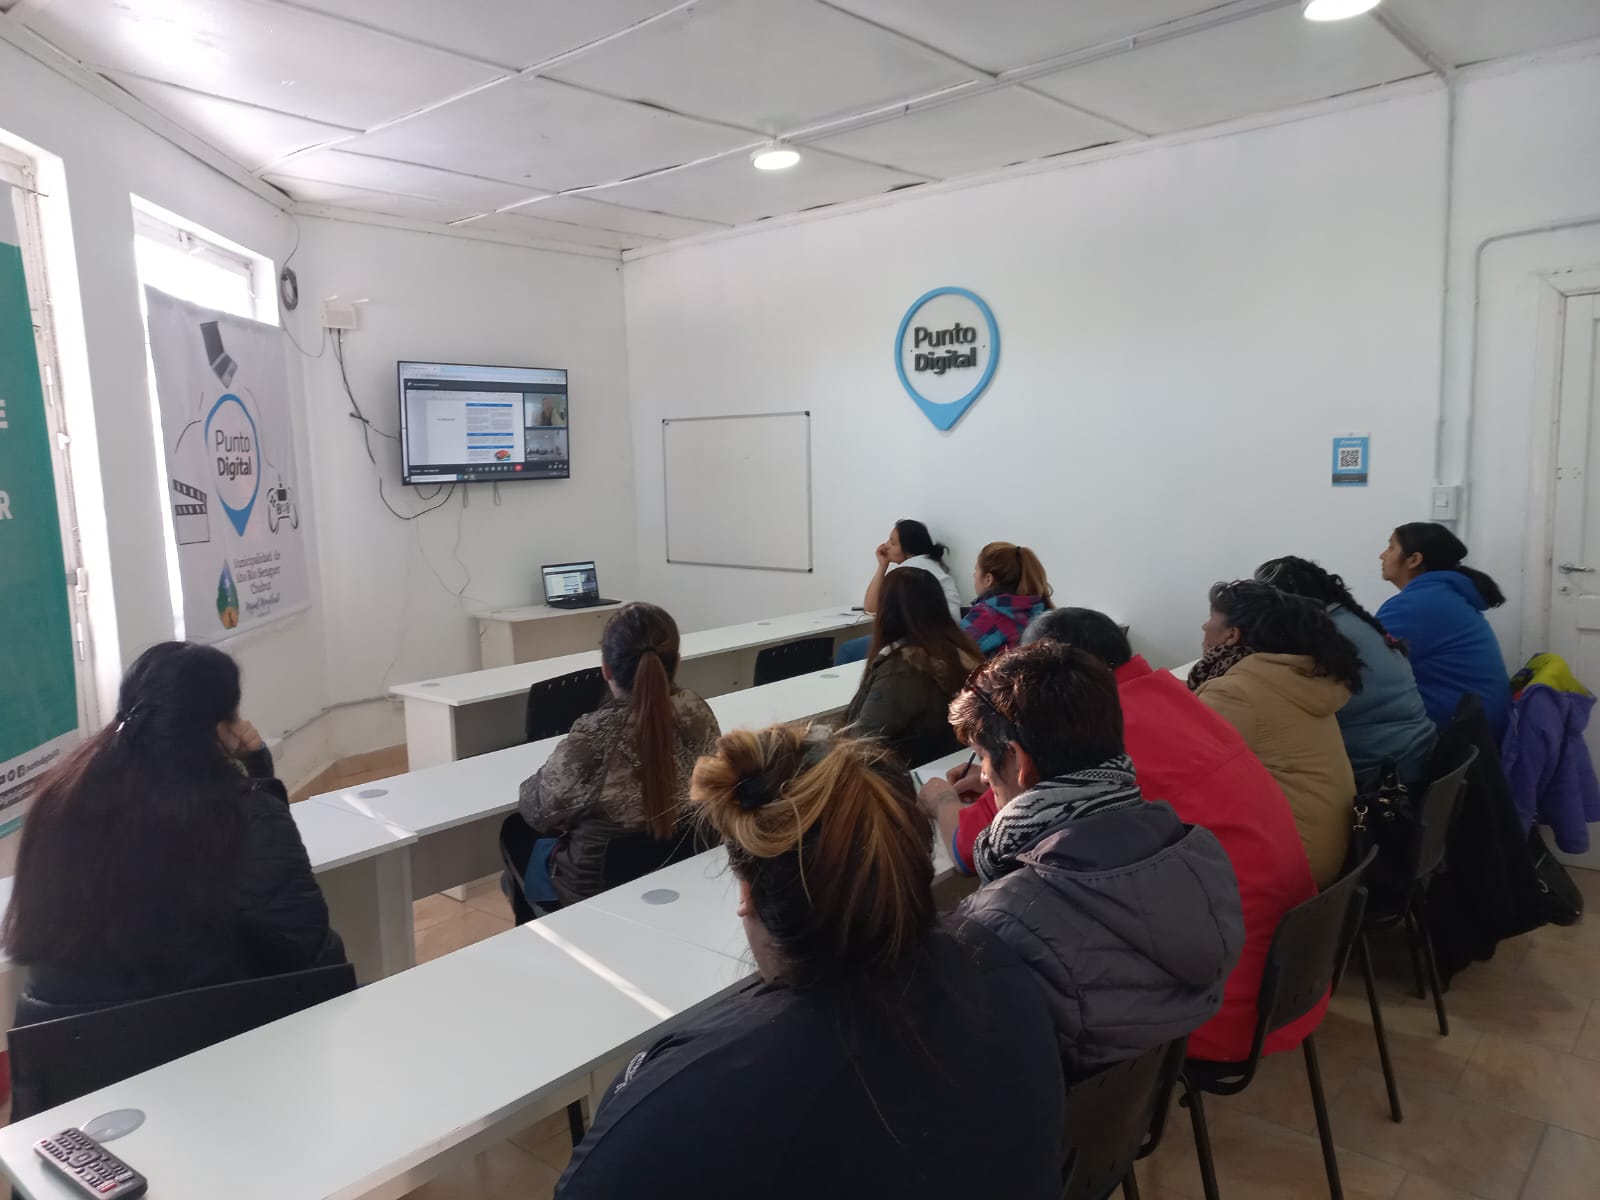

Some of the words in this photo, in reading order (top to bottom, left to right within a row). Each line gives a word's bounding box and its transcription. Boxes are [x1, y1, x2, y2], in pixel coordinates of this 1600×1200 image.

[914, 322, 977, 349] Punto
[914, 347, 977, 375] Digital
[215, 429, 251, 453] Punto
[216, 455, 253, 481] Digital
